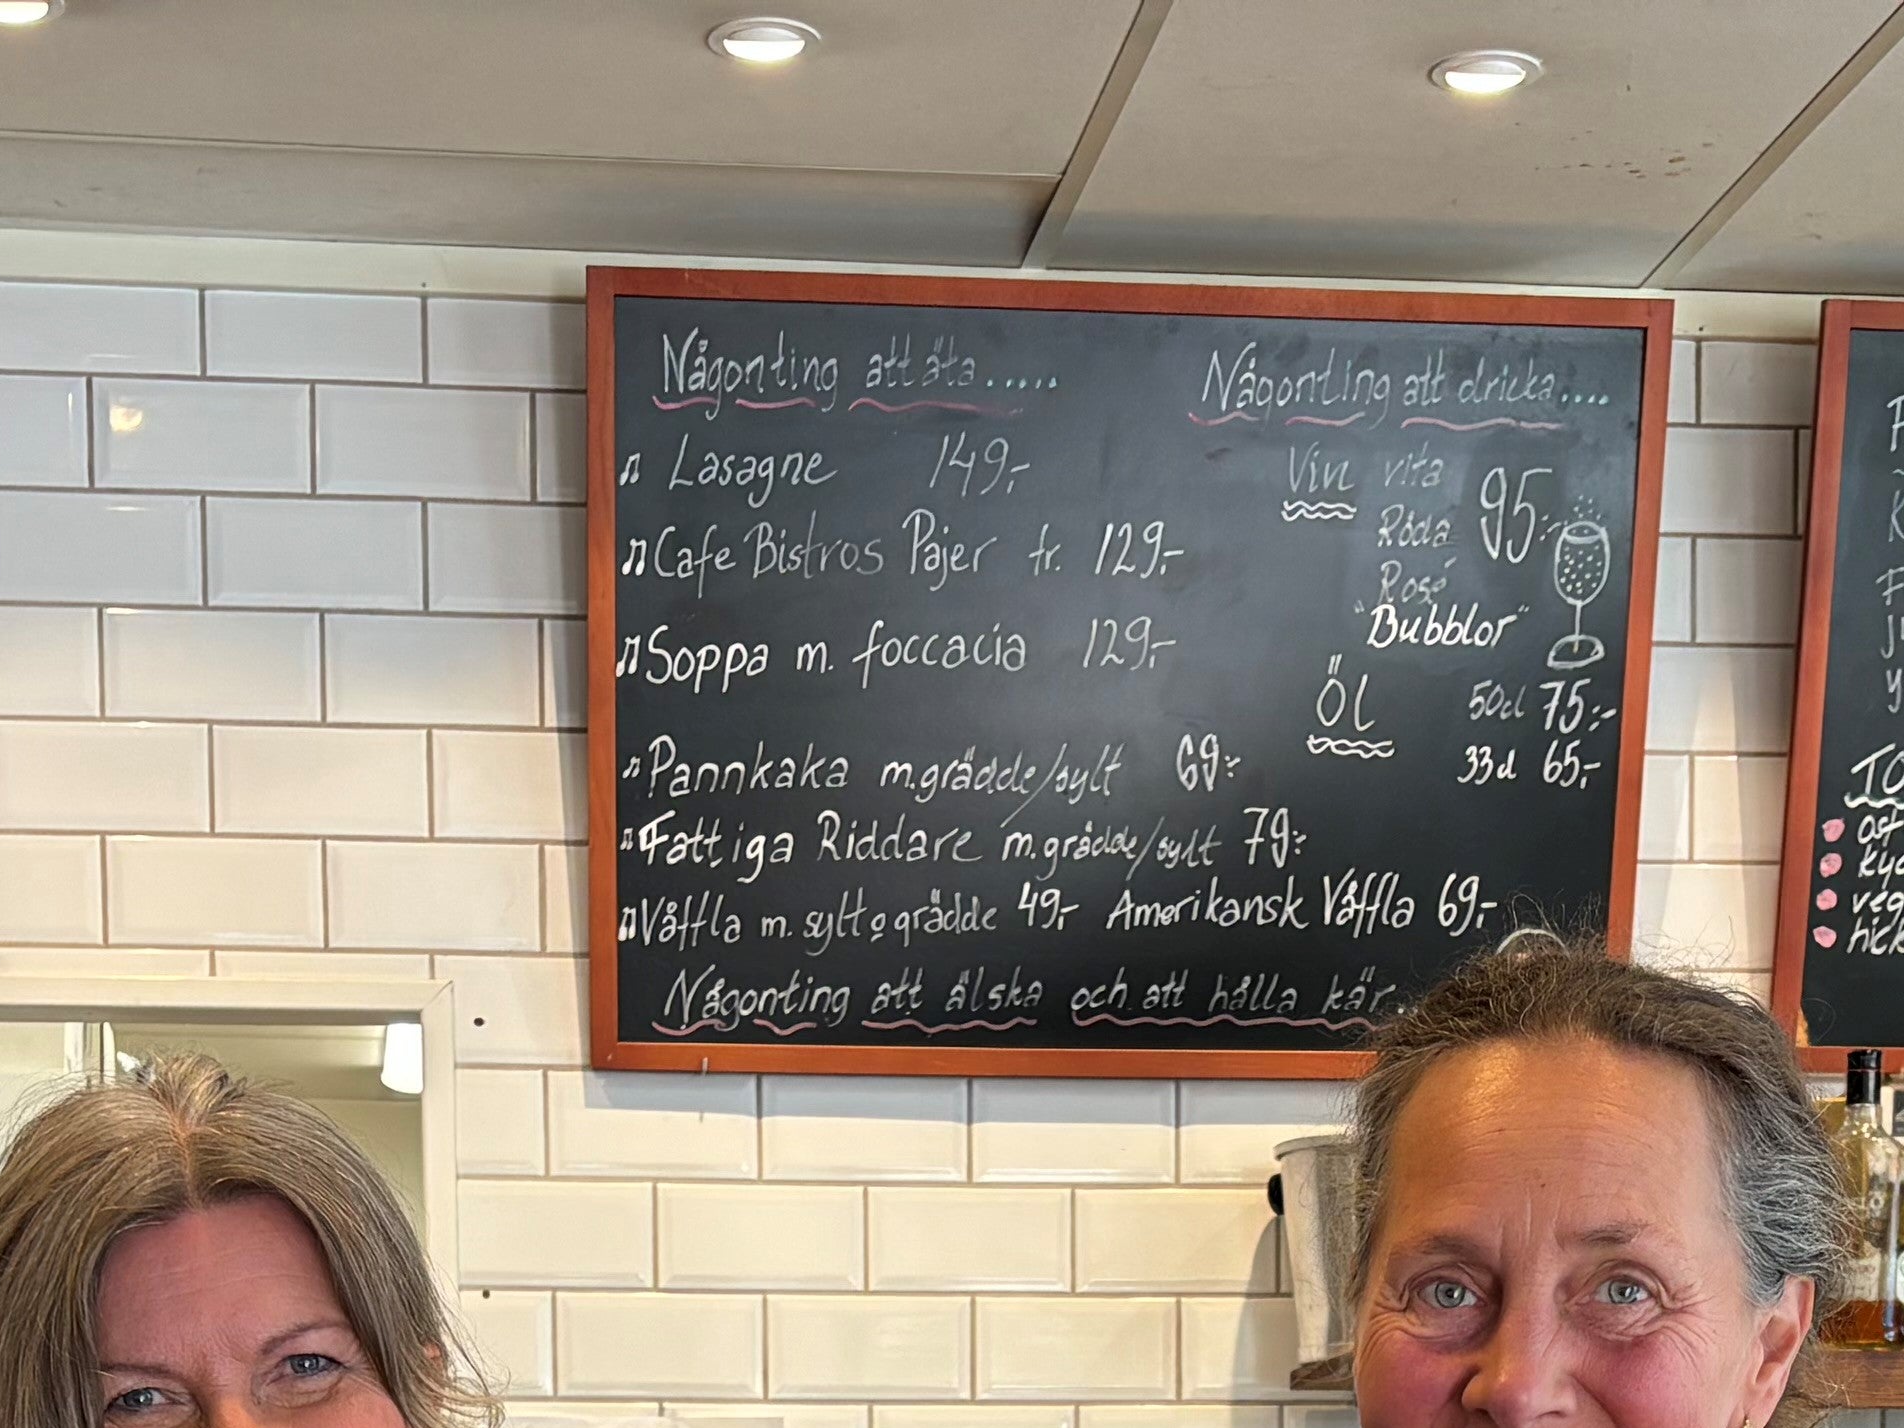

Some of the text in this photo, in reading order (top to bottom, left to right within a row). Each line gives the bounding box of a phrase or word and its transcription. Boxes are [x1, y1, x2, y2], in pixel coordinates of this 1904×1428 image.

[662, 327, 840, 421] Någonting
[865, 332, 910, 388] att
[1201, 341, 1391, 431] Någonting
[1403, 350, 1446, 399] att
[668, 433, 838, 509] Lasagne
[1283, 441, 1355, 495] Vin
[654, 524, 736, 599] Cafe
[744, 509, 883, 580] Bistros
[901, 507, 997, 592] Pajer
[646, 625, 769, 694] Soppa
[796, 638, 834, 673] m.
[852, 620, 1026, 689] foccacia
[1316, 653, 1376, 732] Öl
[648, 733, 850, 799] Pannkaka
[639, 809, 794, 883] Fattiga
[816, 809, 983, 865] Riddare
[802, 887, 868, 956] sylt
[1106, 876, 1310, 931] Amerikansk
[664, 964, 851, 1032] Någonting
[871, 967, 922, 1014] att
[946, 965, 1043, 1012] älska
[1072, 967, 1128, 1012] och
[1145, 967, 1185, 1012] att
